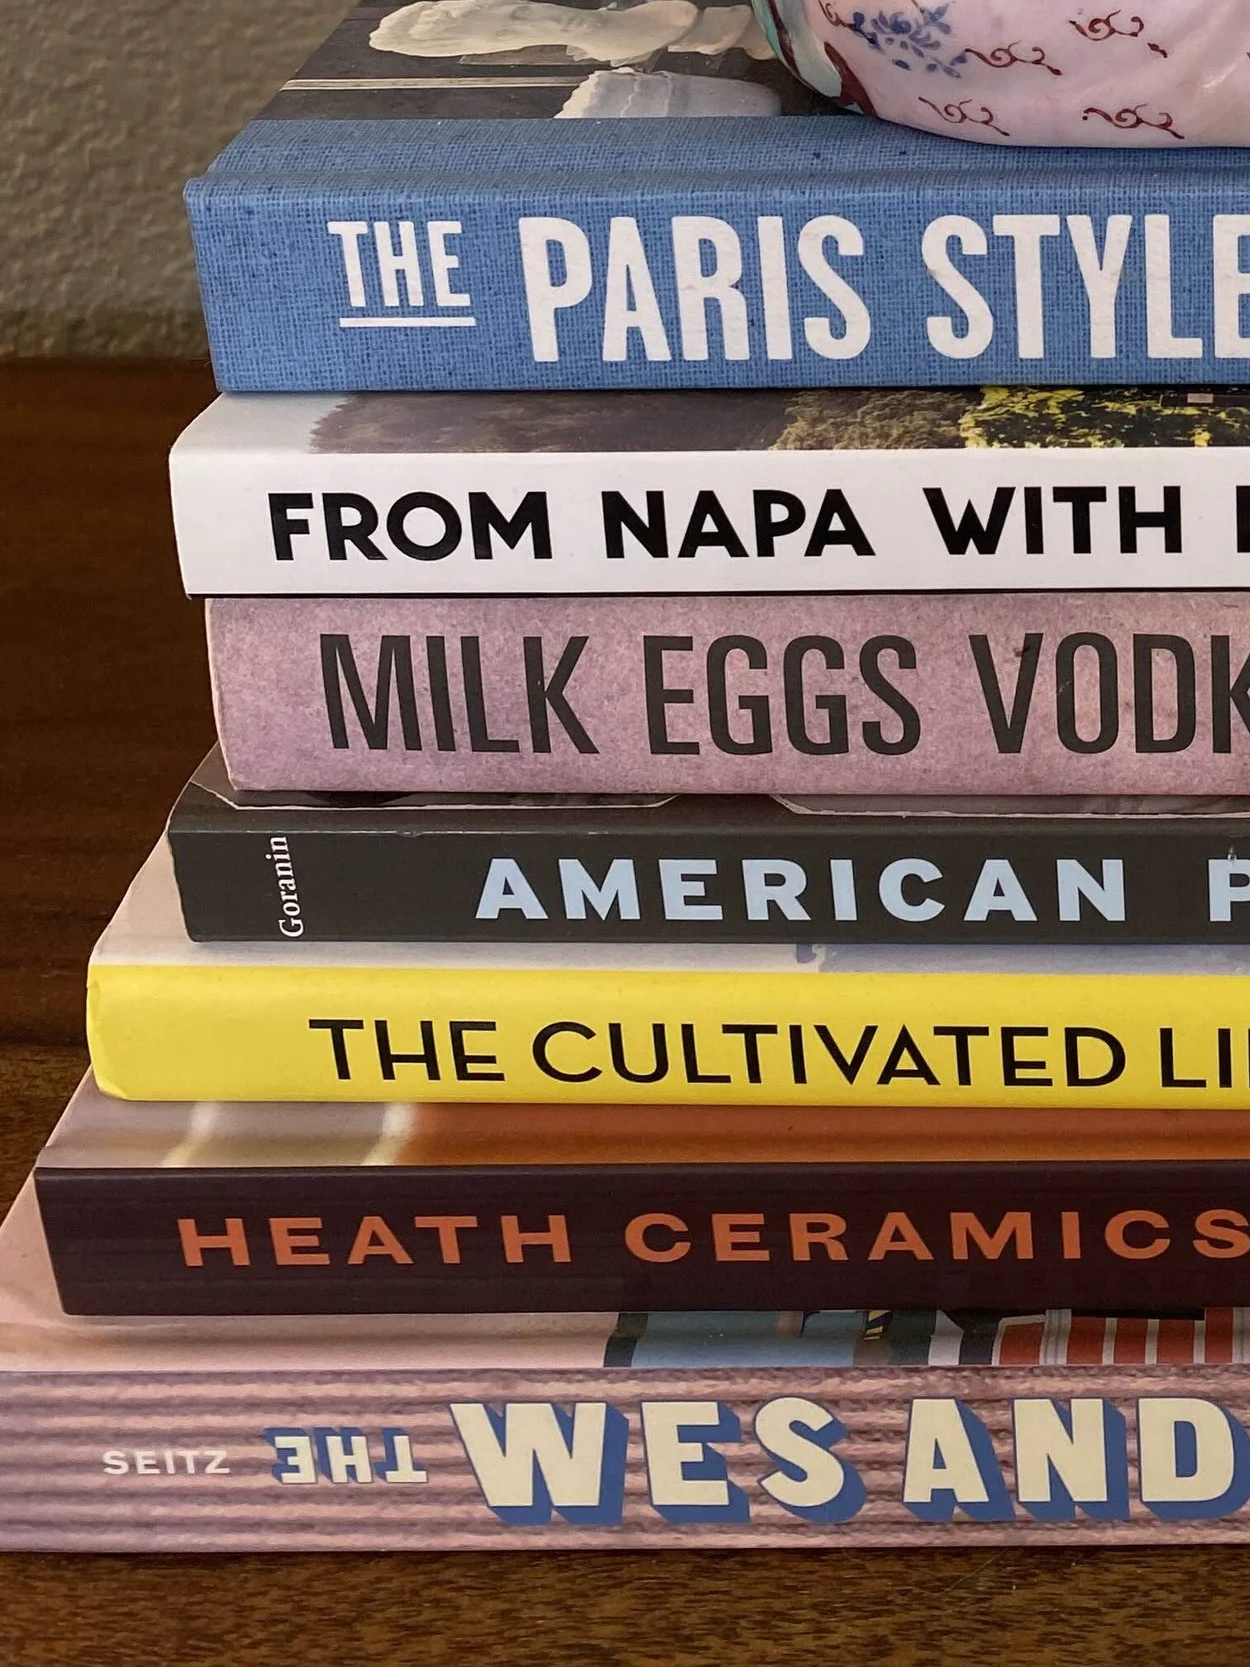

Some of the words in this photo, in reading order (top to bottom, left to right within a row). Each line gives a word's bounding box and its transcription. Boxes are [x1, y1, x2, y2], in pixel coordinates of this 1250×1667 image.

[327, 219, 471, 308] THE
[517, 214, 872, 363] PARIS
[266, 489, 553, 561] FROM
[600, 487, 876, 559] NAPA
[922, 484, 1182, 556] WITH
[318, 633, 601, 756] MILK
[643, 633, 922, 756] EGGS
[271, 835, 305, 939] Goranin
[475, 857, 1126, 923] AMERICAN
[308, 1018, 506, 1083] THE
[531, 1020, 1127, 1088] CULTIVATED
[176, 1213, 573, 1268] HEATH
[101, 1449, 231, 1476] SEITZ
[264, 1426, 429, 1484] THE
[449, 1396, 868, 1525] WES
